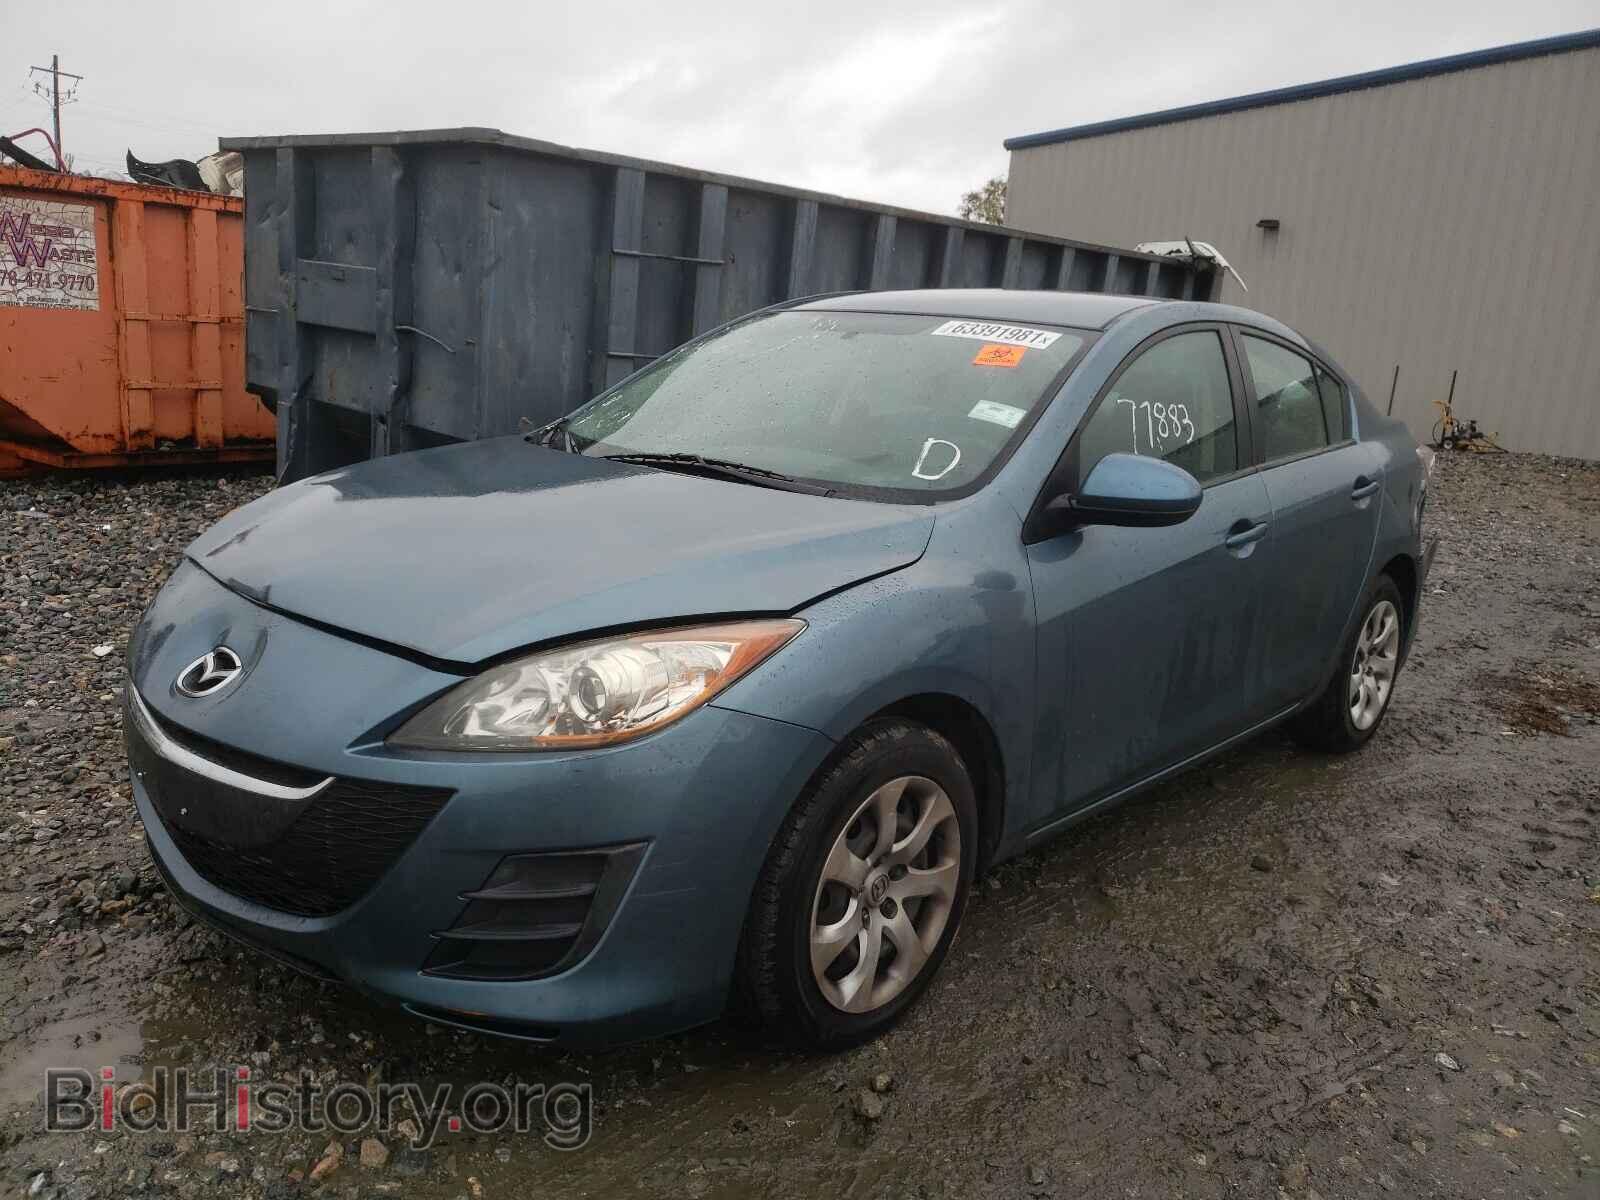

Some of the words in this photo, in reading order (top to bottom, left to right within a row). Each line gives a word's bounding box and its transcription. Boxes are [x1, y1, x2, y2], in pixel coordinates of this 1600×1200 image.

[4, 233, 95, 267] WASTE
[951, 322, 1041, 344] 63391981
[912, 438, 960, 480] D
